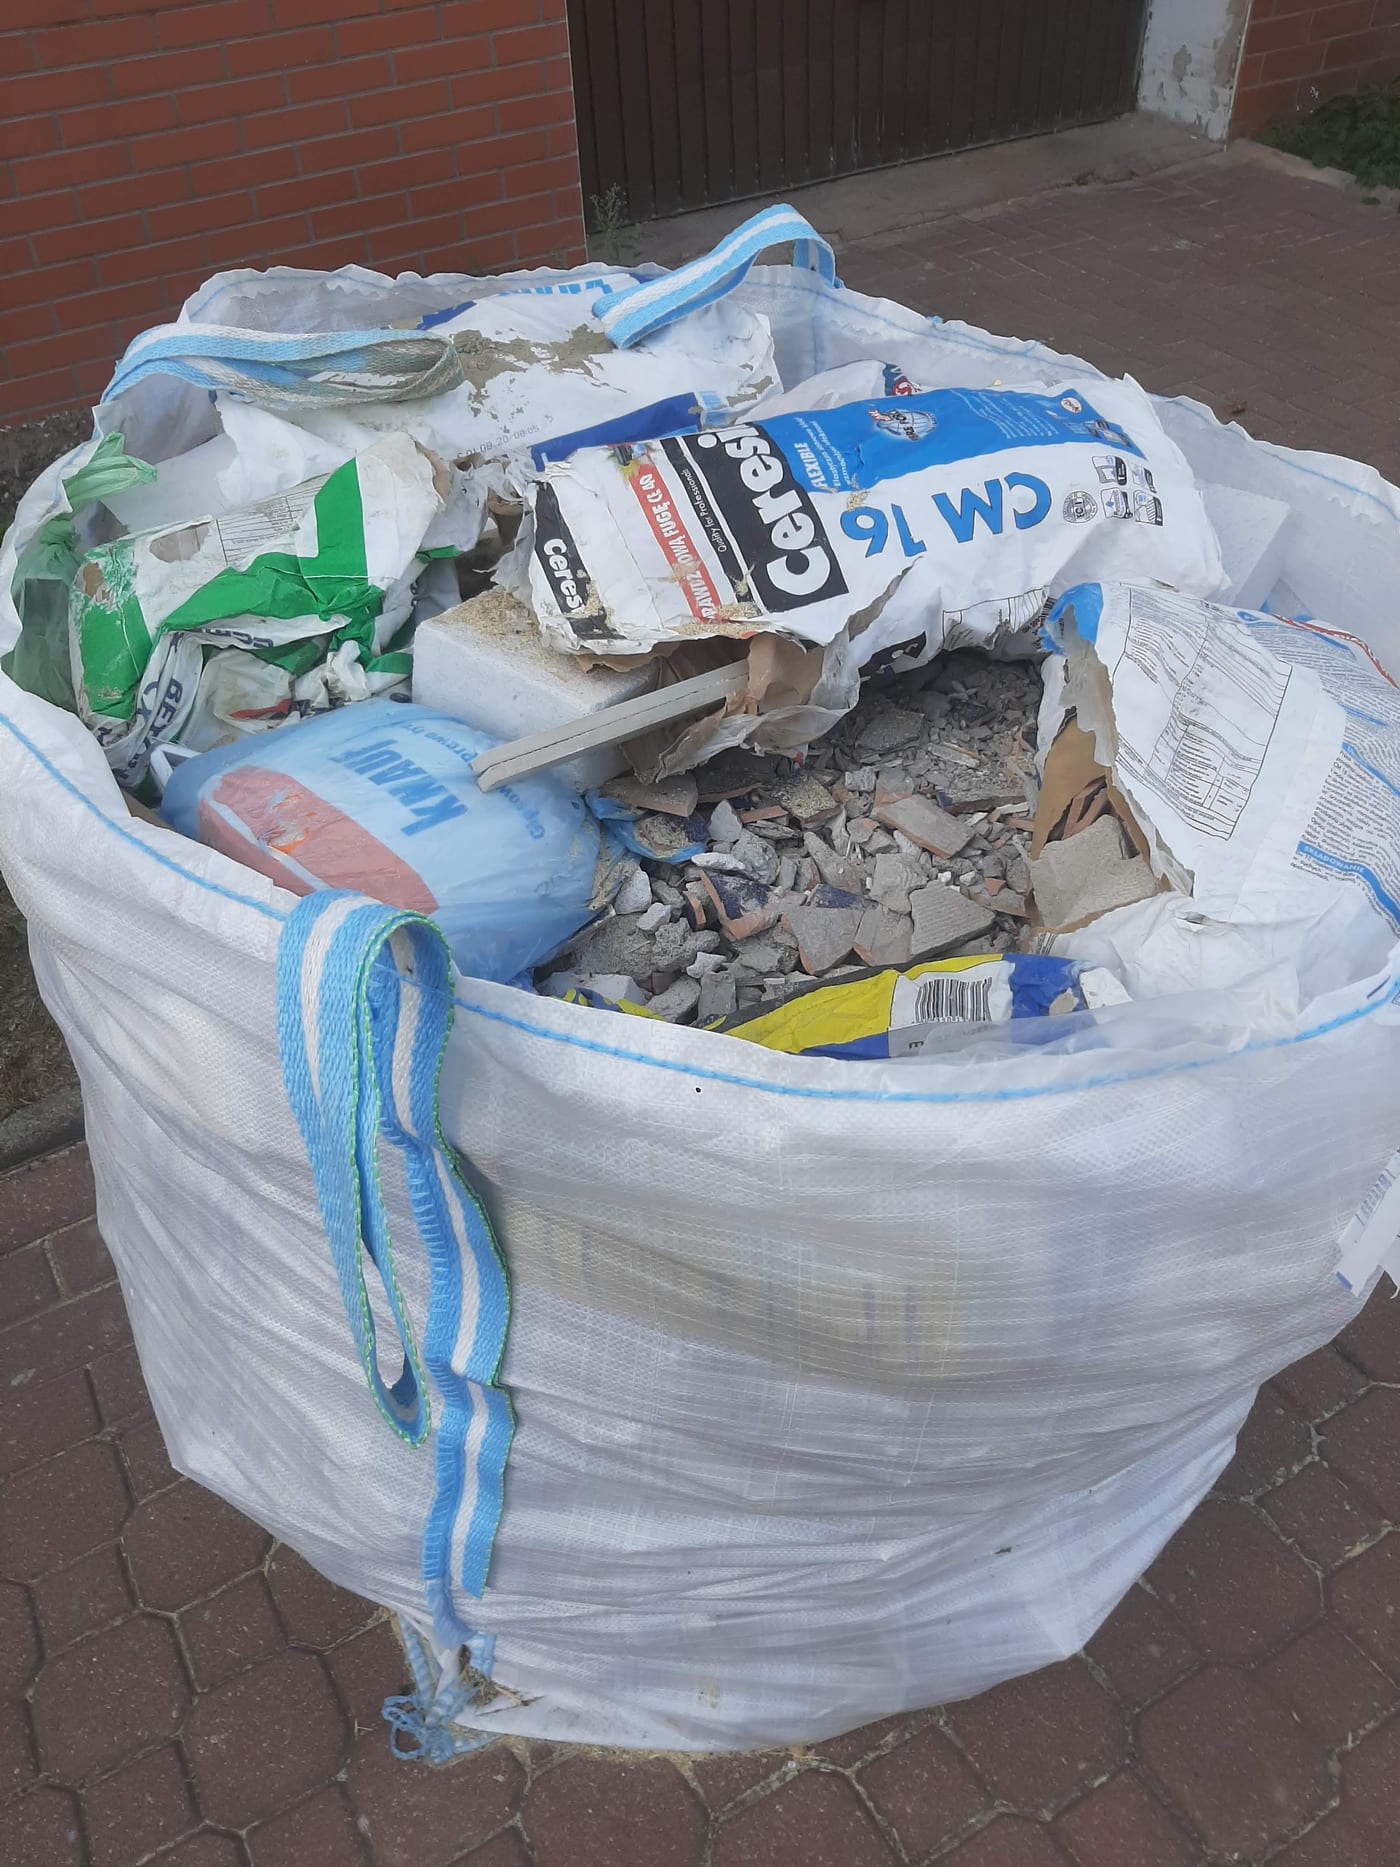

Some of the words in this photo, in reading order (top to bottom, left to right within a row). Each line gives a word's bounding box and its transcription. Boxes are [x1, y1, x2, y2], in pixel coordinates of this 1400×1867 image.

[638, 473, 656, 492] 40
[793, 442, 829, 488] FLEXIBLE
[646, 488, 664, 503] CE
[931, 471, 1052, 545] CM
[651, 500, 680, 539] FUGĘ
[704, 516, 716, 528] for
[839, 503, 928, 559] 16
[668, 534, 696, 570] OWĄ
[710, 528, 728, 553] Quality
[327, 738, 469, 837] KNAUF
